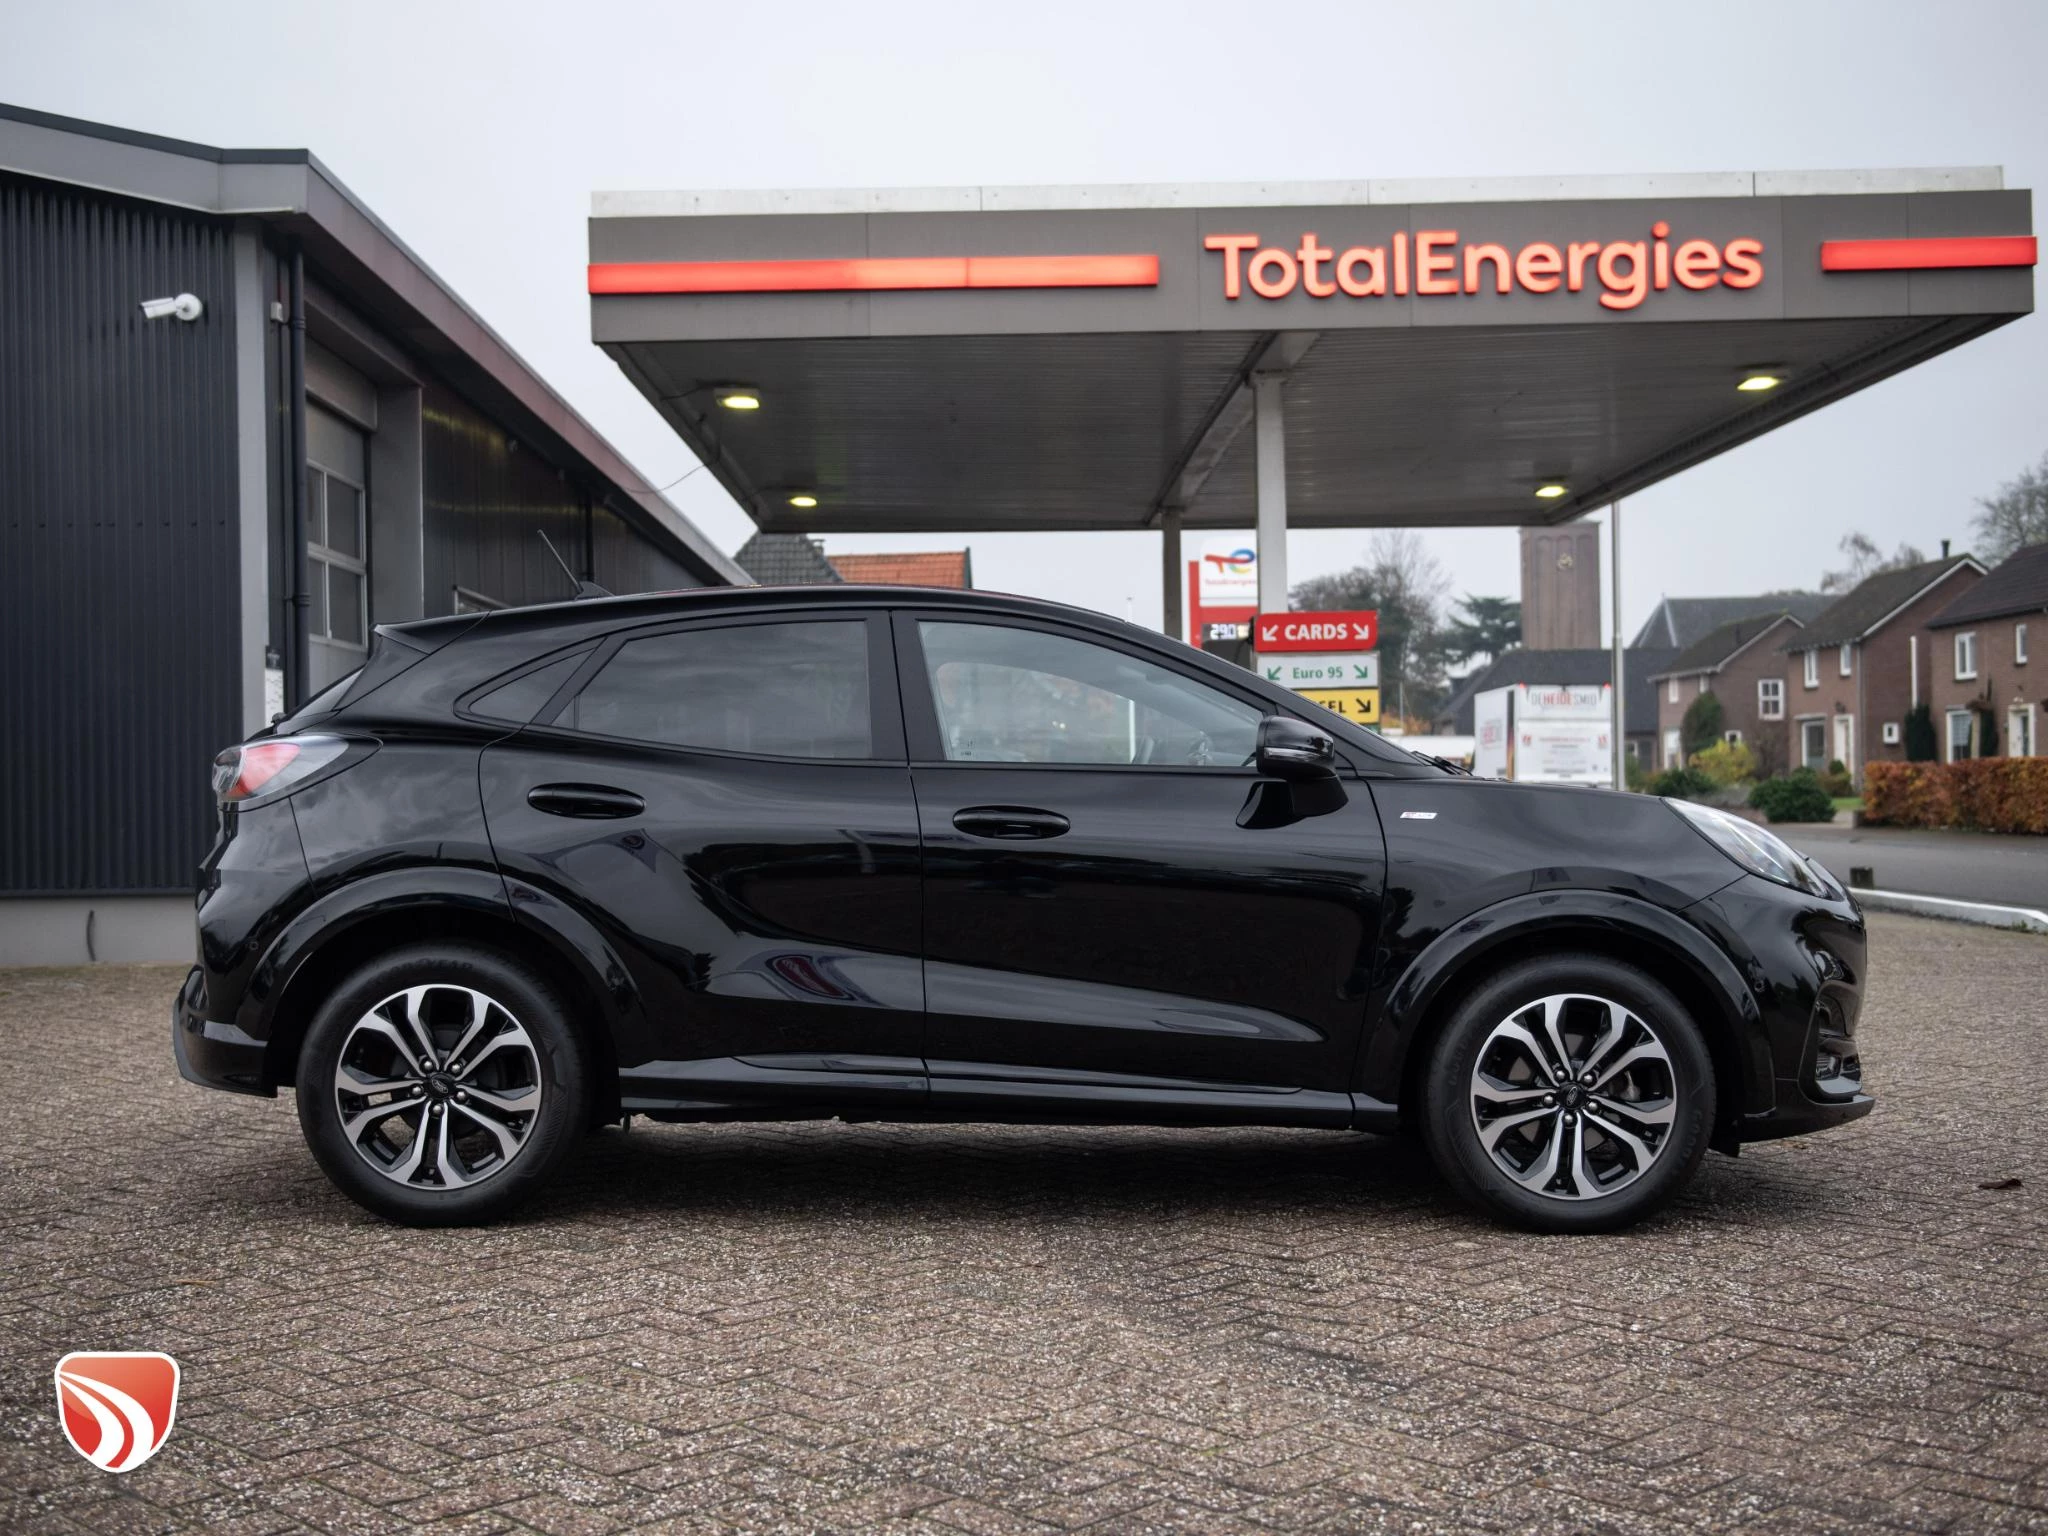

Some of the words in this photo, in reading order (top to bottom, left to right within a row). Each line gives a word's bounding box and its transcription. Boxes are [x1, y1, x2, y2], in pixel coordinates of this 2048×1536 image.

[1204, 222, 1764, 310] TotalEnergies
[1284, 623, 1348, 640] CARDS
[1292, 667, 1323, 679] Euro
[1327, 666, 1343, 678] 95
